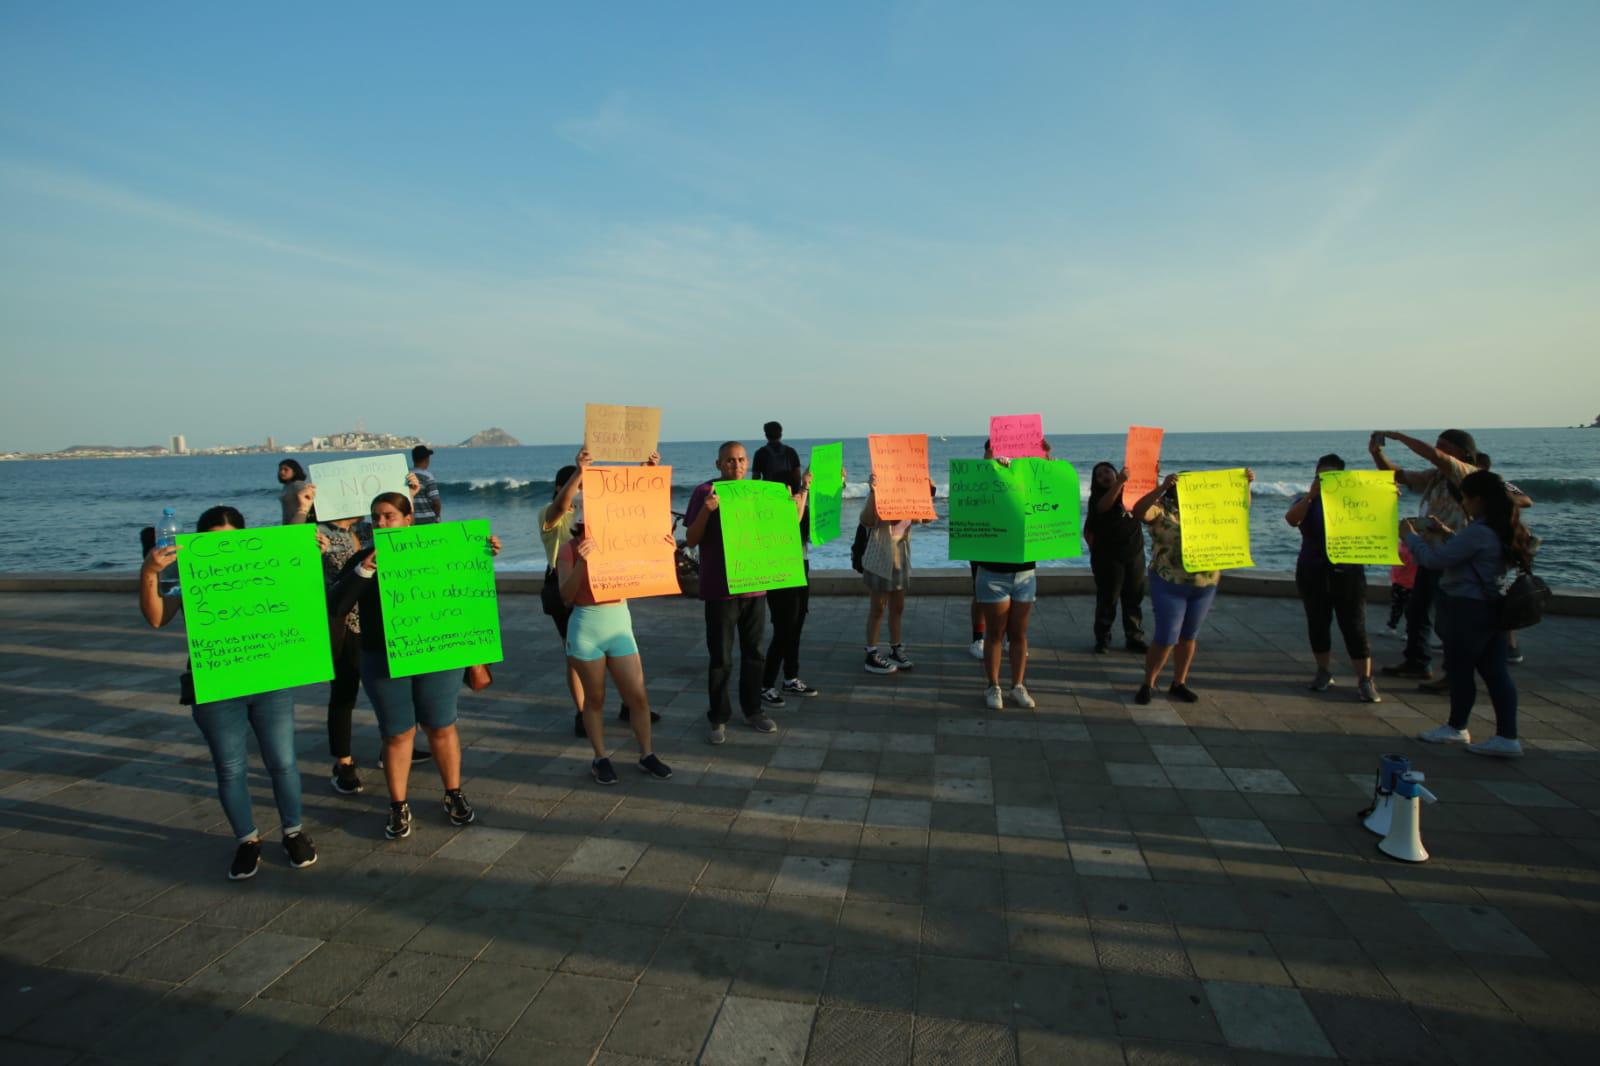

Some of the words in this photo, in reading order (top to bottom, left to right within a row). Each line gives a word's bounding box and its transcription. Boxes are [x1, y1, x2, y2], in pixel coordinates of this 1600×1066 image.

[340, 473, 382, 497] NO
[585, 467, 665, 500] Justicia
[188, 535, 264, 558] Cero
[375, 530, 449, 553] Tambien
[189, 556, 281, 580] tolerancia
[288, 556, 303, 567] a
[381, 564, 440, 581] mujeres
[189, 575, 277, 605] gresores
[197, 597, 291, 626] Sexuales
[391, 614, 423, 634] por
[430, 606, 463, 621] una
[279, 627, 300, 638] NO
